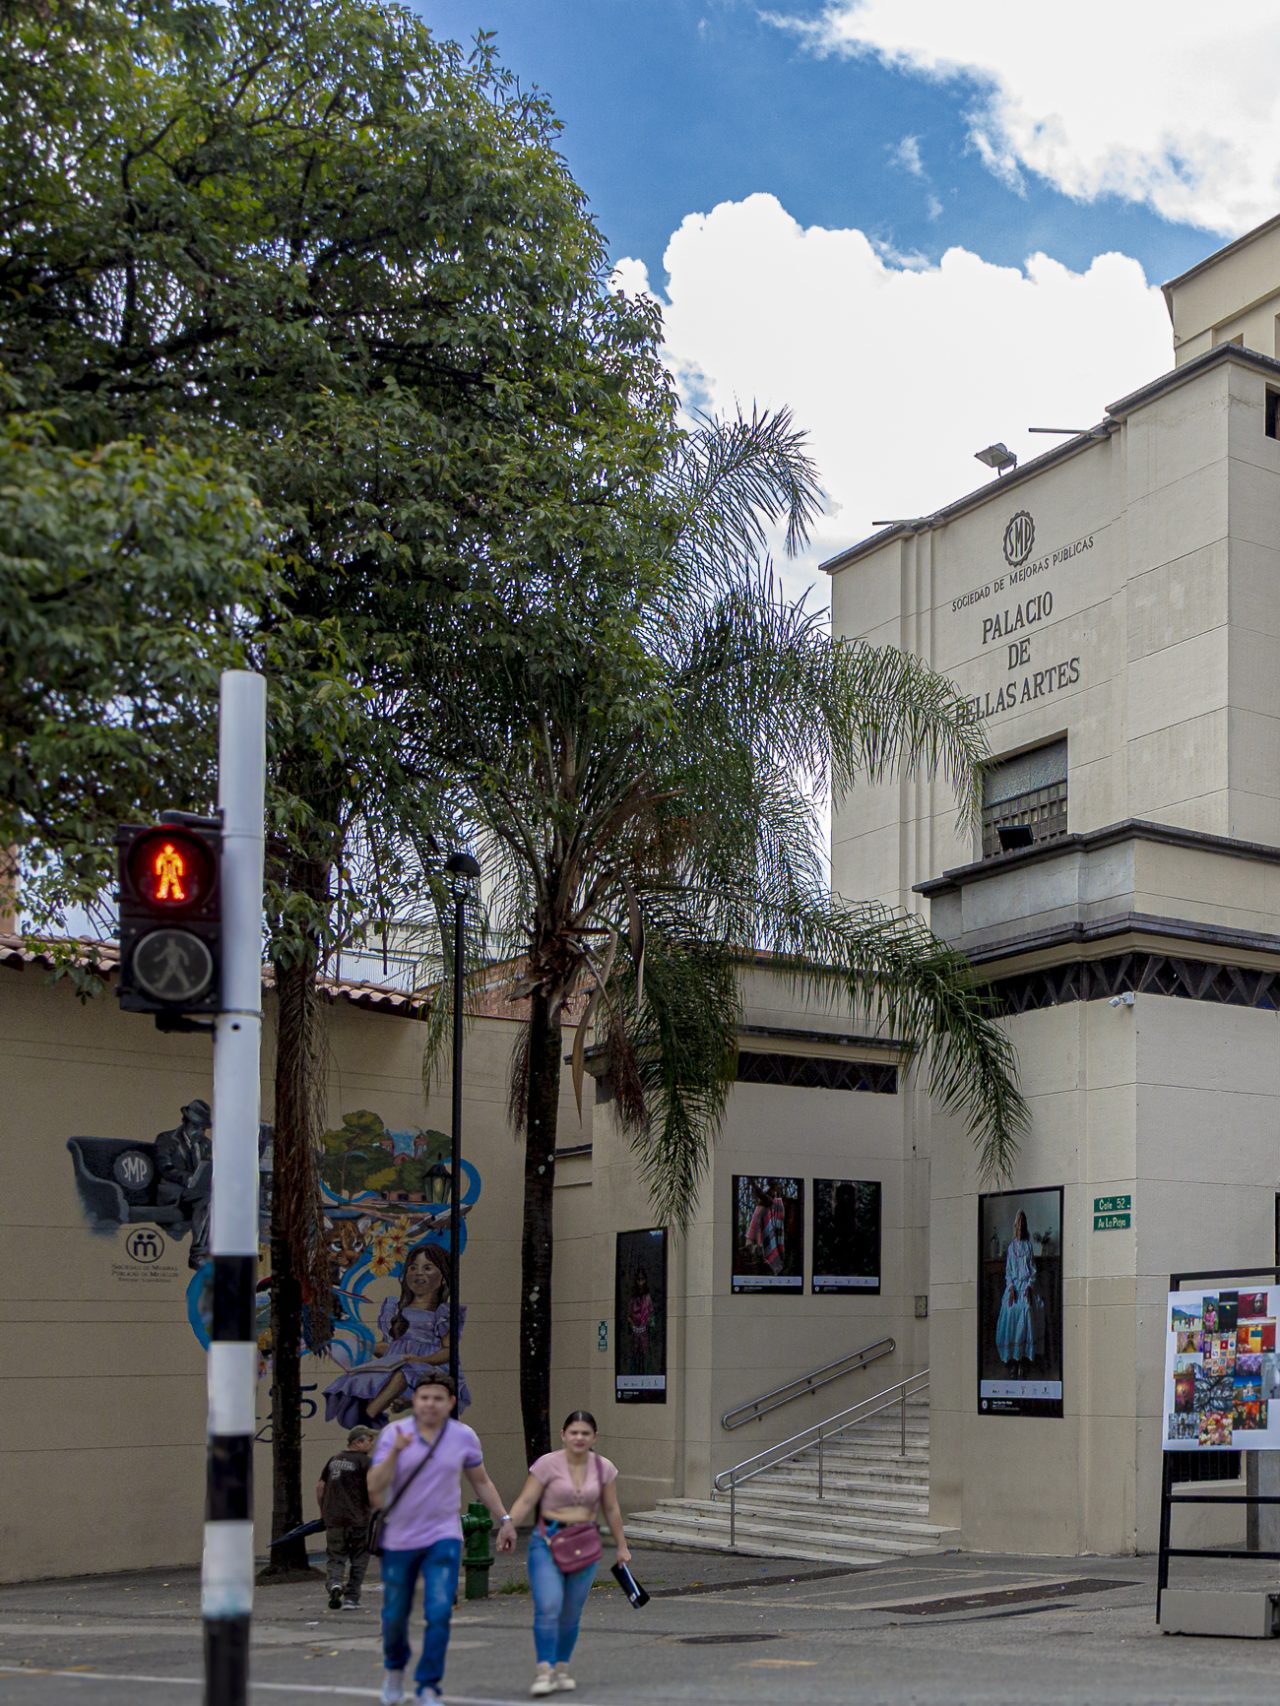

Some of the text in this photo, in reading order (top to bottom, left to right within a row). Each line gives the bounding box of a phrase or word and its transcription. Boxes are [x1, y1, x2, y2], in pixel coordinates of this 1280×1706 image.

[1008, 517, 1032, 558] SMP
[952, 586, 991, 612] SOCIEDAD
[993, 579, 1005, 594] DE
[1009, 558, 1050, 586] MEJORAS
[982, 591, 1053, 645] PALACIO
[1007, 637, 1031, 670] DE
[1020, 657, 1080, 704] ARTES
[121, 1156, 148, 1183] SMP
[1116, 1198, 1126, 1209] 52
